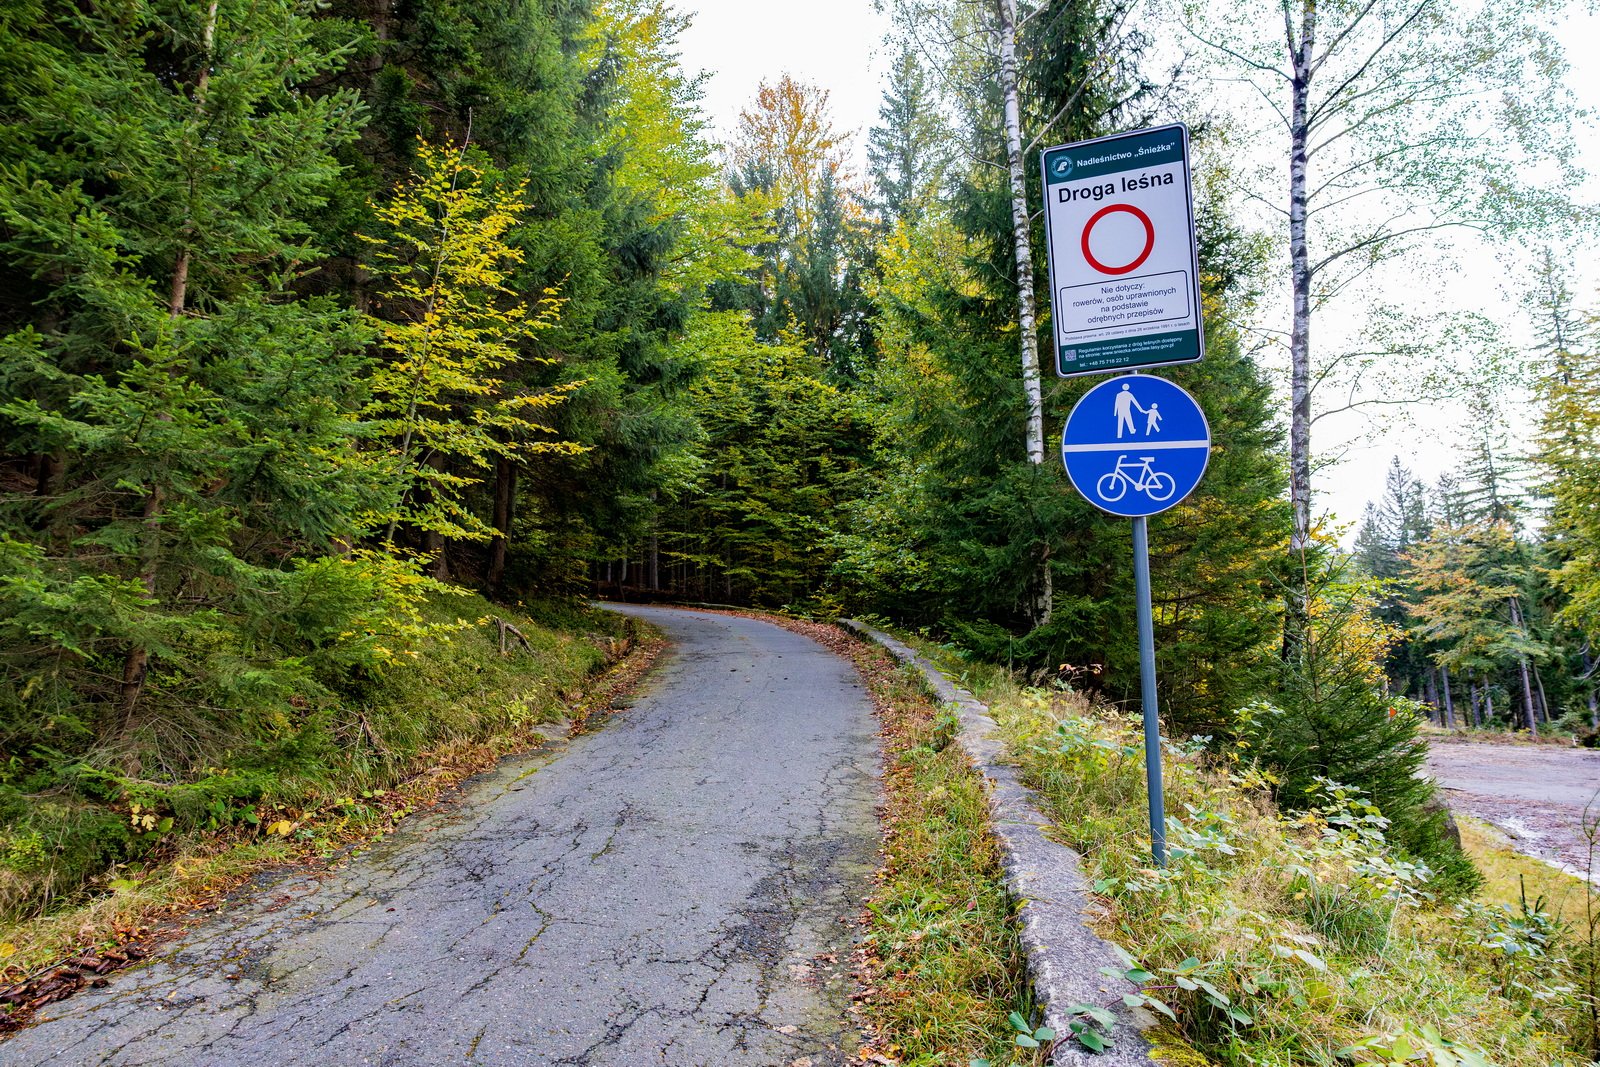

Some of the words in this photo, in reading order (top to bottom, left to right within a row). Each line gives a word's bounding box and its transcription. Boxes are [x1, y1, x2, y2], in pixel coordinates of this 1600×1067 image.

[1077, 152, 1132, 167] Nadleśnictwo
[1058, 182, 1114, 202] Droga
[1121, 172, 1174, 192] leśna
[1101, 286, 1114, 295] Nie
[1115, 282, 1146, 293] dotyczy:
[1072, 298, 1105, 308] rowerów,
[1106, 294, 1124, 303] osób
[1125, 286, 1177, 300] uprawnionych
[1100, 305, 1111, 313] na
[1111, 300, 1149, 312] podstawie
[1087, 312, 1126, 324] odrębnych
[1126, 307, 1164, 320] przepisów
